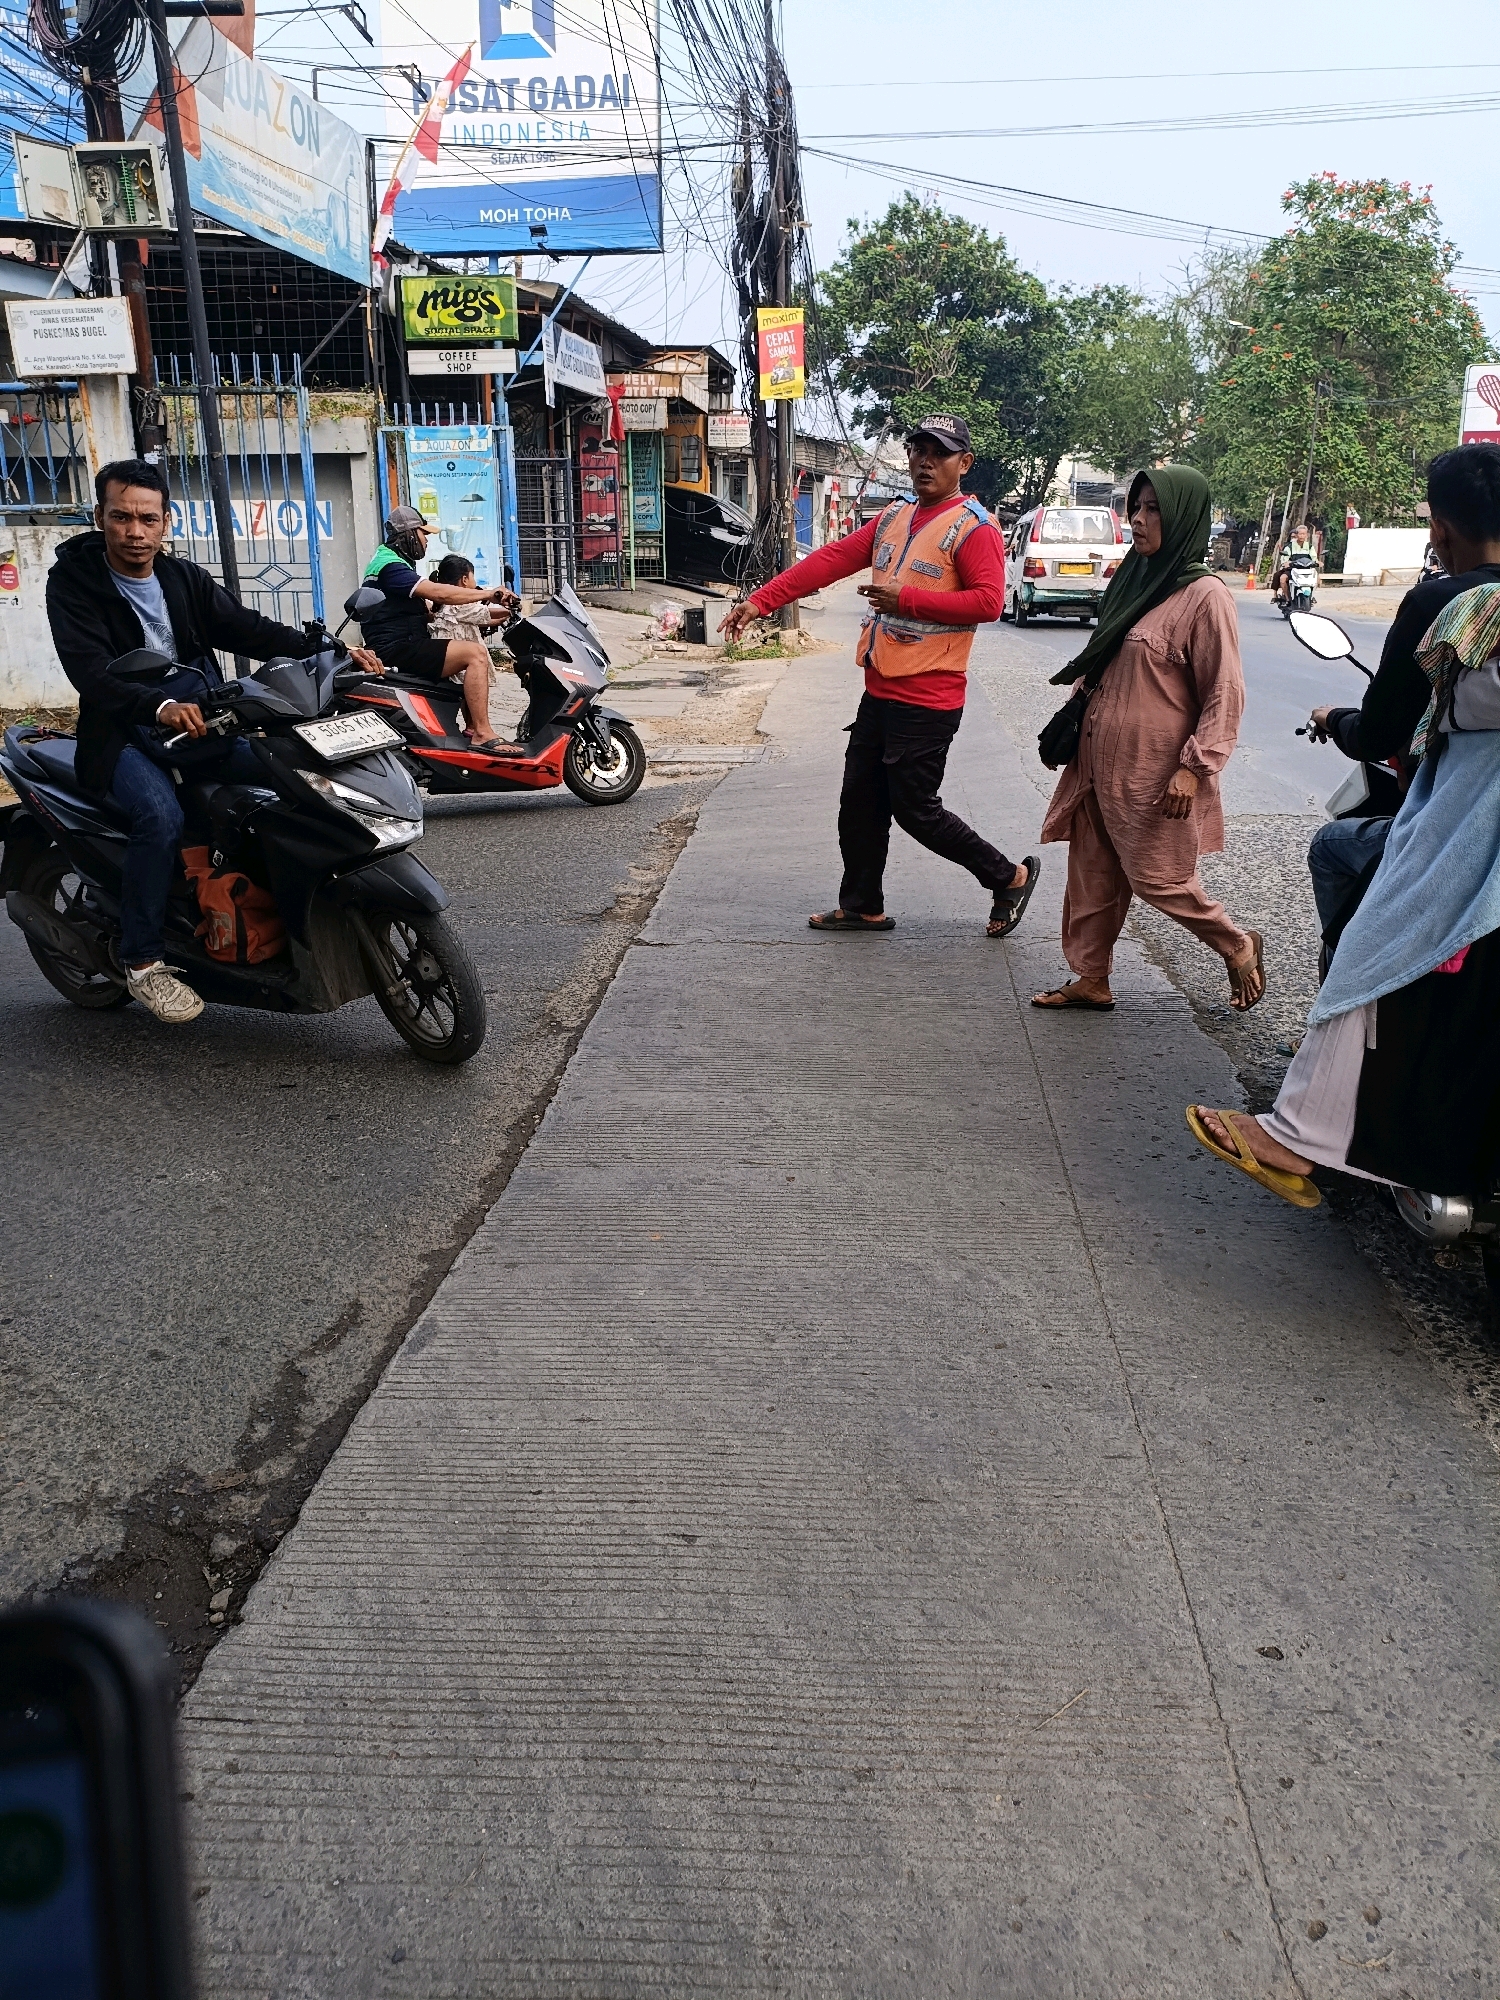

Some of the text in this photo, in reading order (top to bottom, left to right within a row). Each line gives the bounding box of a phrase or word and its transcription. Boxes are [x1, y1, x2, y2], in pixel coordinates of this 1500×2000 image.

[528, 73, 630, 111] GADAI
[453, 122, 591, 145] INDONESIA
[491, 153, 529, 165] SEJAK
[480, 207, 572, 223] MOH TOHA
[75, 306, 104, 314] TANGERANG
[762, 312, 798, 326] maxim
[33, 326, 107, 339] PUSKESMAS BUGEL
[424, 326, 496, 335] SOCIAL SPACE
[766, 330, 795, 347] CEPAT
[438, 352, 477, 362] COFFEE
[768, 344, 797, 358] SAMPAI
[447, 363, 472, 373] SHOP
[624, 374, 655, 386] HELM
[652, 387, 679, 397] COPY
[640, 404, 656, 414] COPY
[427, 440, 471, 451] AQUAZON
[170, 501, 333, 539] QUAZON
[302, 729, 317, 741] B
